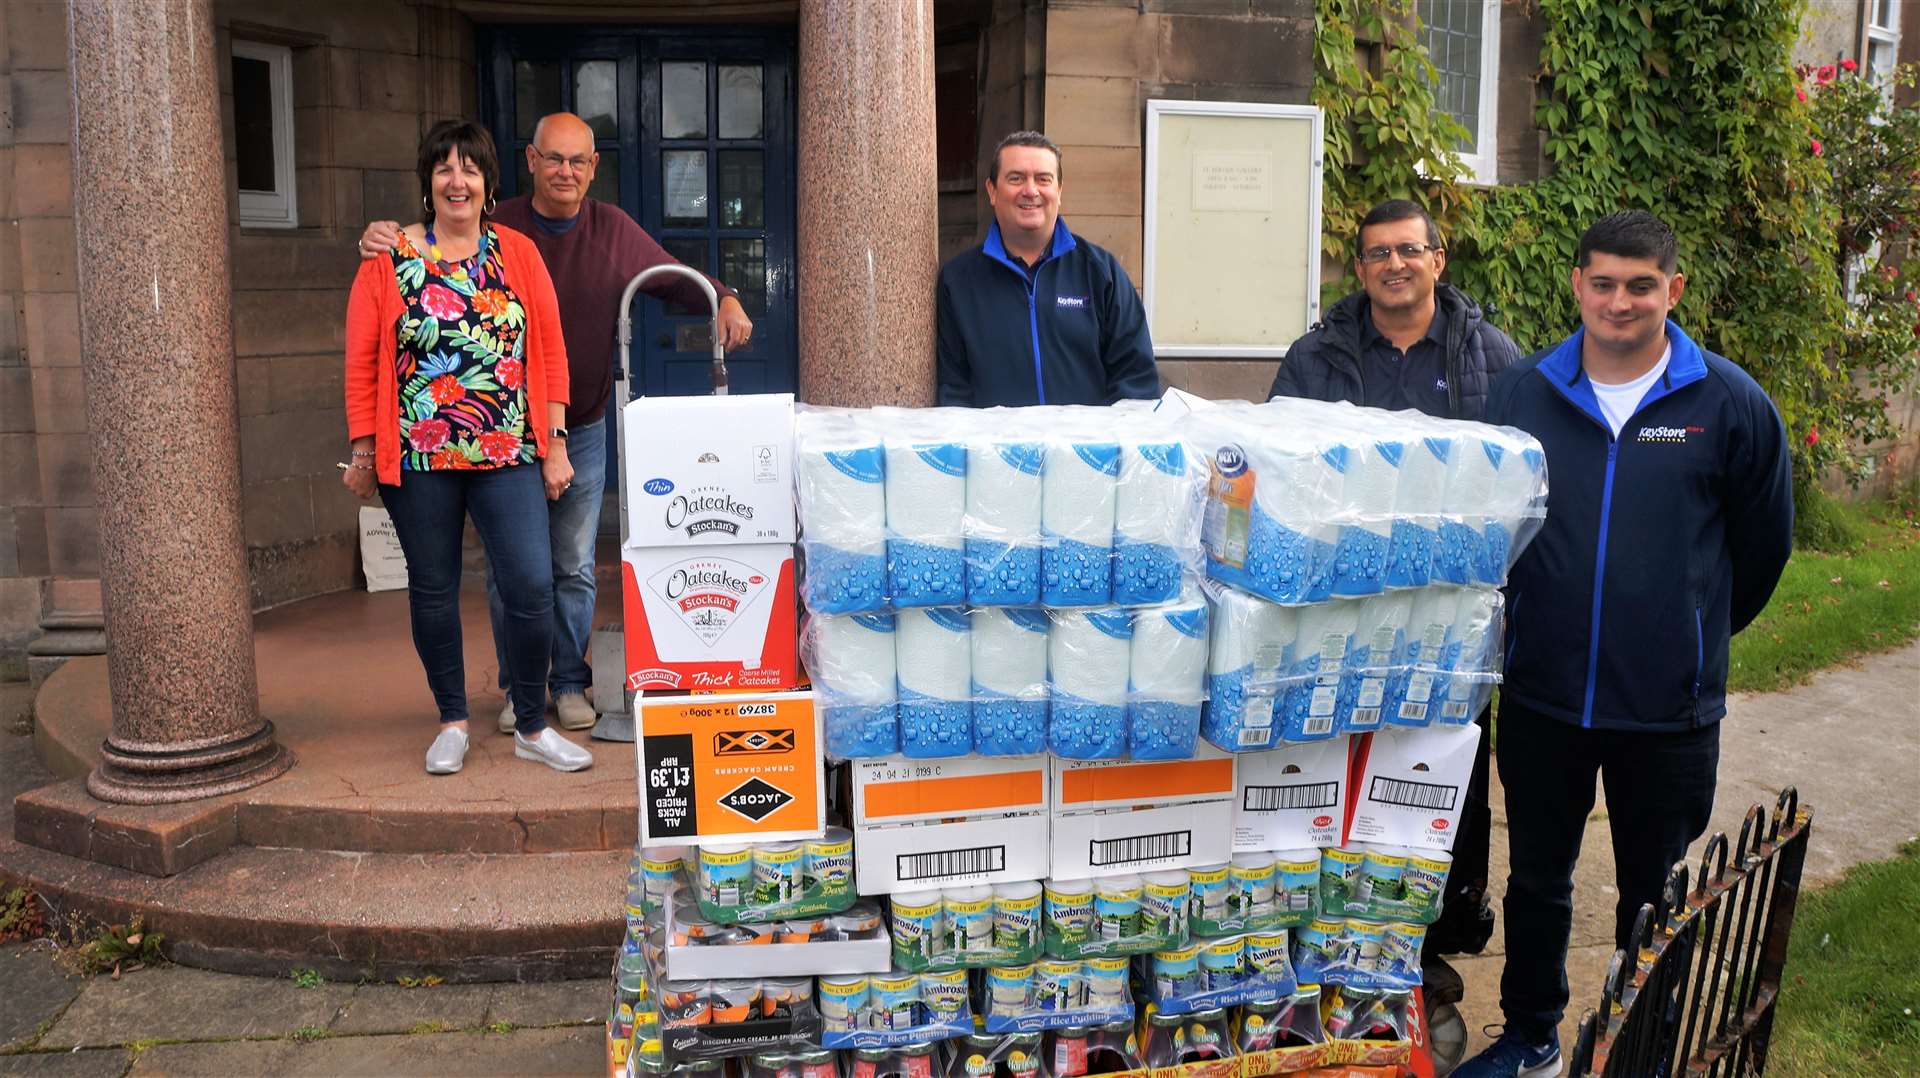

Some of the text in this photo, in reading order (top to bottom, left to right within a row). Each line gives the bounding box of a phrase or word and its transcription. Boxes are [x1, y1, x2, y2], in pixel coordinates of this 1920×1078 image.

[1639, 426, 1686, 438] KeyStore
[648, 481, 671, 494] Thin
[691, 486, 726, 494] ORKNEY
[666, 494, 754, 530] Oatcakes
[691, 519, 735, 535] Stockan's
[666, 569, 748, 600] Oatcakes
[685, 594, 733, 609] Stockan's
[637, 671, 674, 682] Stockan's
[760, 669, 780, 677] Milled
[692, 672, 734, 686] Thick
[739, 677, 780, 686] Oatcakes
[689, 708, 712, 717] 300g
[724, 708, 735, 716] 12
[739, 704, 774, 715] 38769
[660, 757, 678, 767] RRP
[936, 766, 942, 775] C
[651, 767, 690, 787] £1.39
[666, 788, 676, 796] AT
[656, 797, 687, 807] PRICED
[731, 792, 781, 806] JACOB'S
[658, 808, 687, 817] PACKS
[665, 818, 681, 828] ALL
[1221, 995, 1239, 1004] Rice
[1050, 1016, 1069, 1025] Rice
[1071, 1012, 1109, 1025] Pudding
[672, 1036, 699, 1050] Epicure
[702, 1038, 731, 1046] DISCOVER
[887, 1034, 907, 1043] Rice
